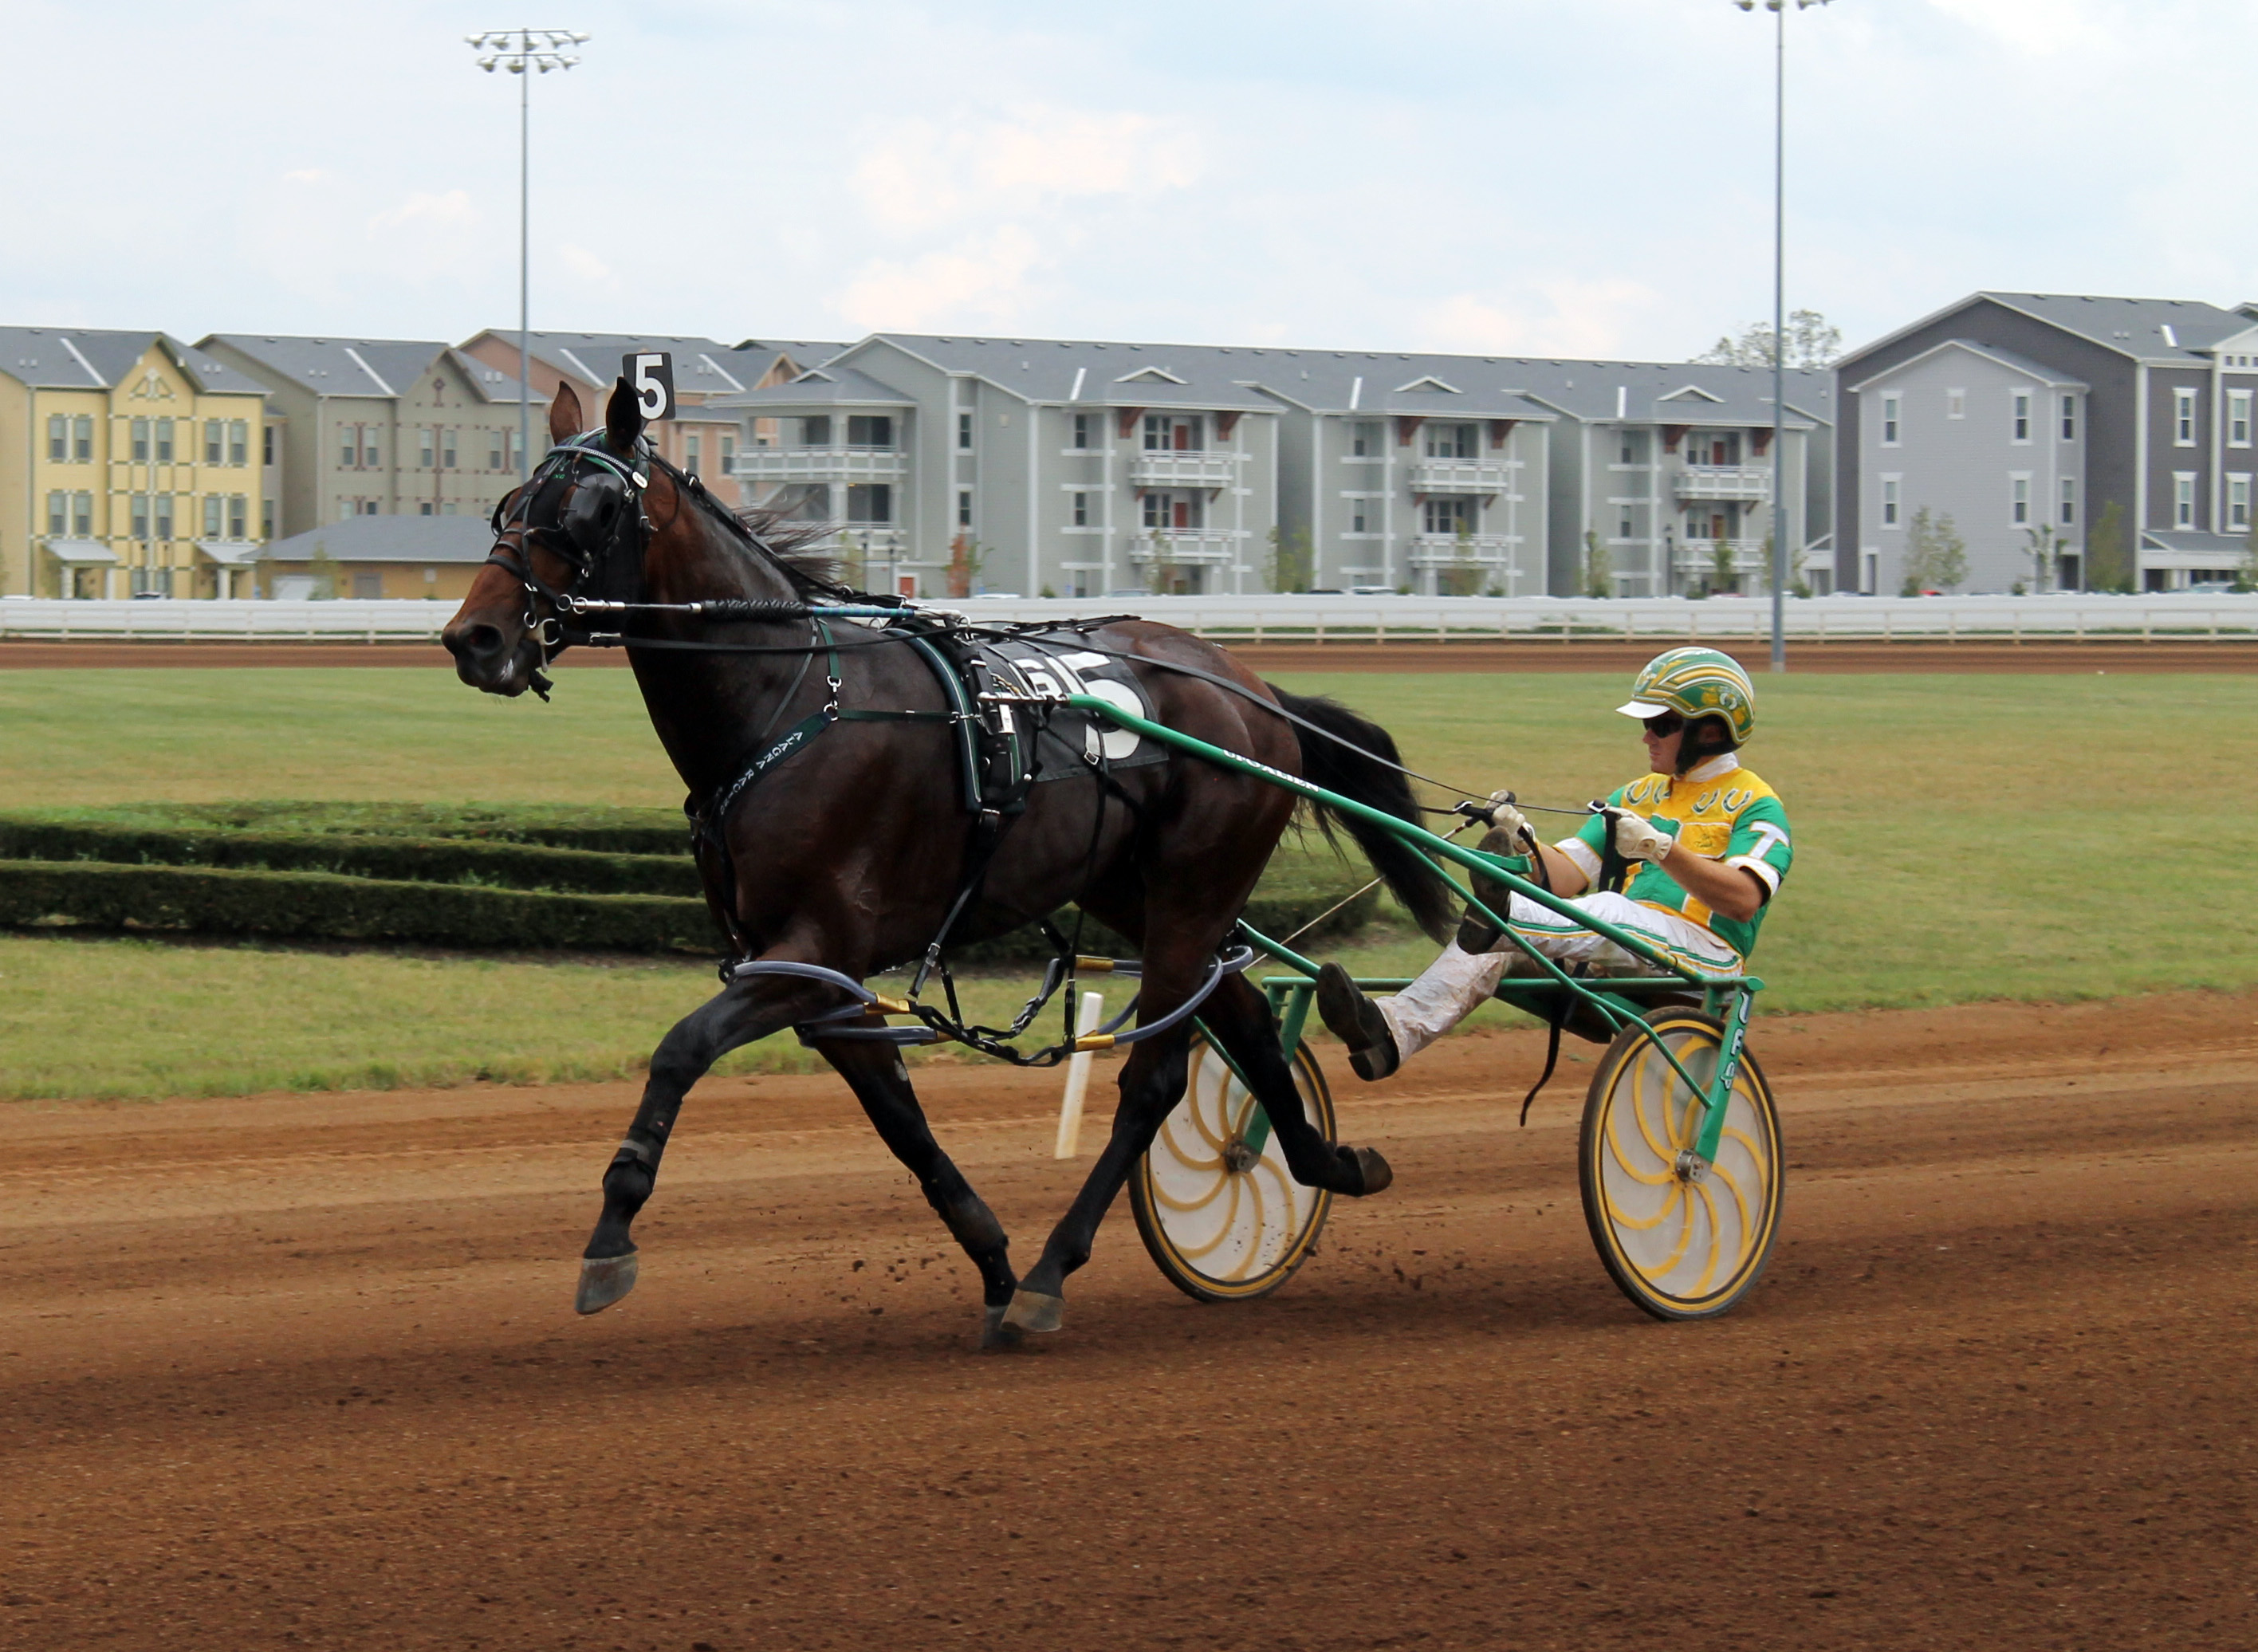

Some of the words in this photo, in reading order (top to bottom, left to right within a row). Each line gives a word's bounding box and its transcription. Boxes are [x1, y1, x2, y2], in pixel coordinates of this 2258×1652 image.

[635, 354, 667, 420] 5
[755, 731, 803, 769] ALAGNA
[1749, 820, 1790, 859] T
